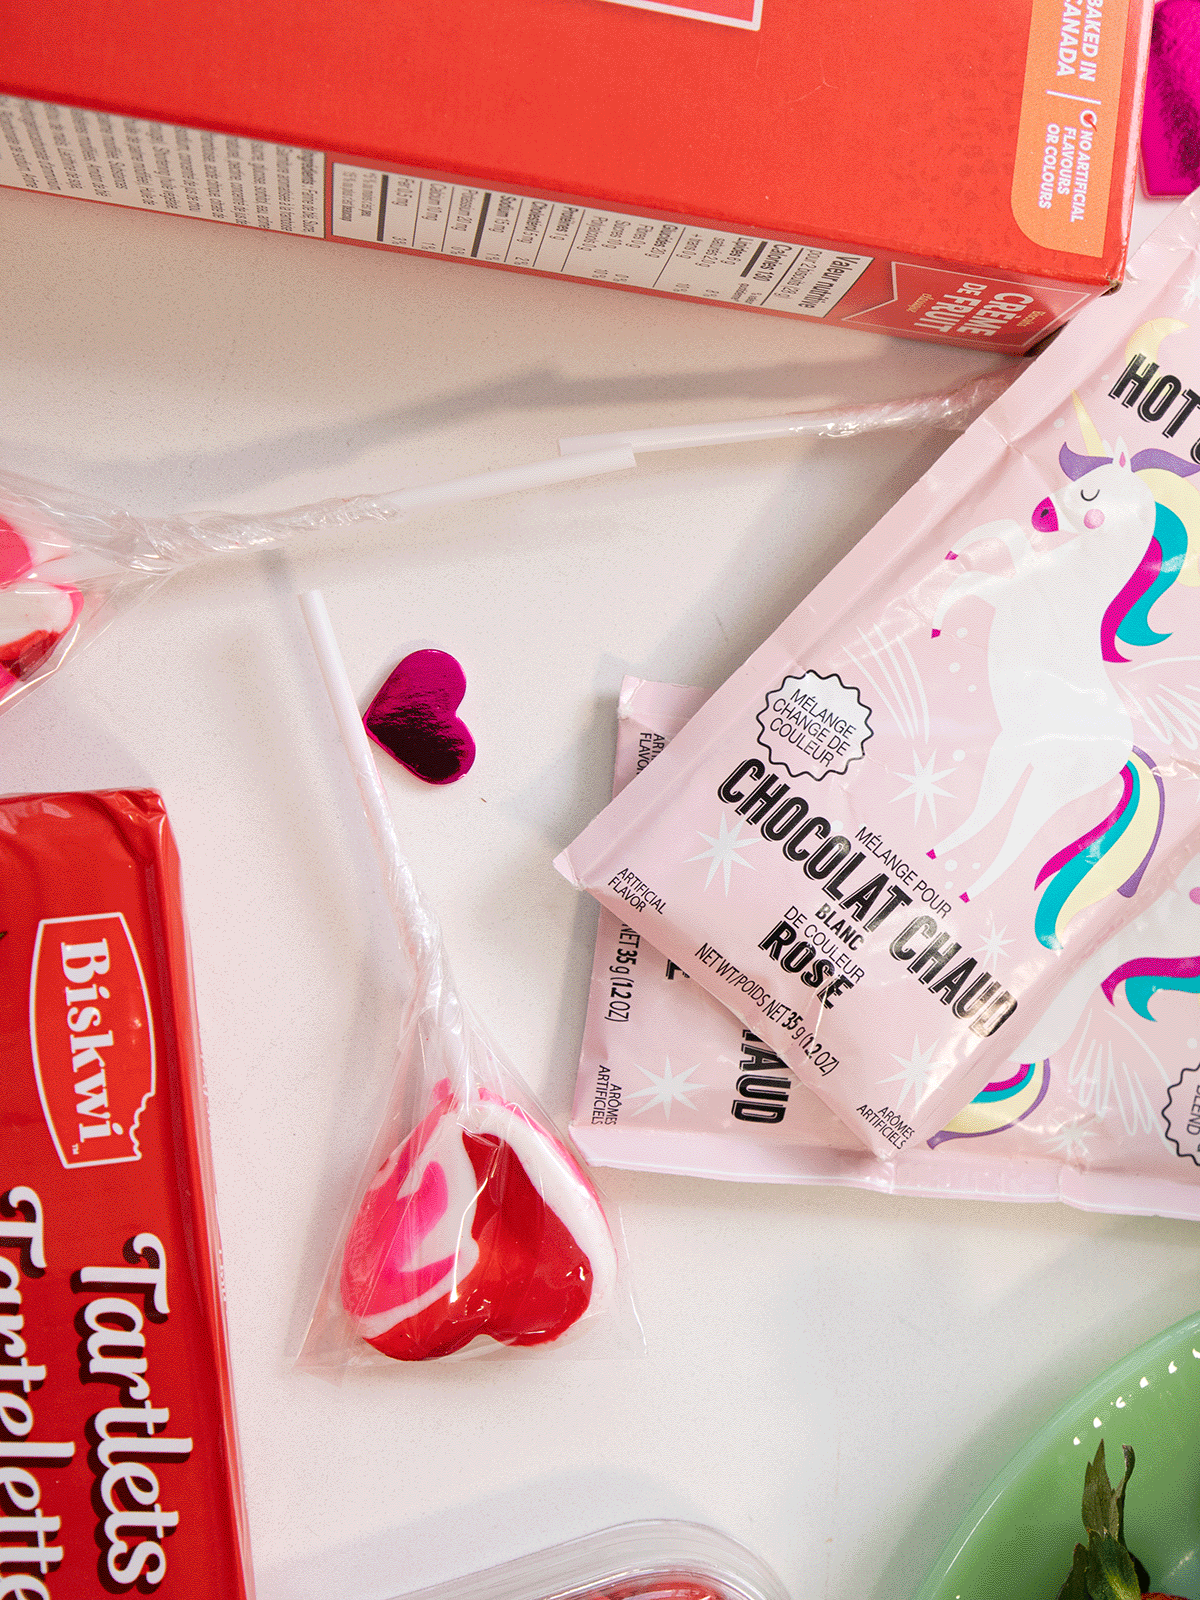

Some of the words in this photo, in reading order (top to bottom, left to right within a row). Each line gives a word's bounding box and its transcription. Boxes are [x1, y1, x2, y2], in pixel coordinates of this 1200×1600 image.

[1082, 0, 1103, 57] BAKED
[1079, 60, 1097, 82] IN
[1046, 123, 1060, 144] OR
[1079, 130, 1093, 151] NO
[1057, 126, 1077, 195] FLAVOURS
[1038, 145, 1058, 209] COLOURS
[1070, 151, 1091, 222] ARTIFICIAL
[497, 195, 517, 218] Sodium
[525, 201, 548, 232] Cholestérol
[556, 206, 579, 232] Protéines
[609, 220, 631, 238] Sucres
[654, 224, 678, 248] Glucides
[729, 237, 753, 257] Lipides
[760, 244, 793, 270] Calories
[804, 249, 823, 264] pour
[752, 271, 774, 282] 130
[821, 257, 861, 282] Valeur
[798, 281, 834, 308] nutritive
[957, 282, 987, 296] DE
[914, 294, 982, 332] FRUIT
[956, 292, 1034, 336] CRÈME
[772, 698, 830, 743] CHANGE
[827, 735, 851, 756] DE
[790, 688, 856, 739] MÉLANGE
[769, 717, 834, 767] COULEUR
[855, 826, 918, 886] MÉLANGE
[912, 879, 952, 919] POUR
[608, 876, 646, 913] FLAVOR
[615, 868, 666, 915] ARTIFICIAL
[717, 758, 913, 932] CHOCOLAT
[889, 916, 1018, 1037] CHAUD
[619, 923, 639, 948] NET
[815, 903, 863, 951] BLANC
[616, 948, 638, 965] 35
[694, 942, 722, 968] NET
[783, 905, 808, 929] DE
[804, 924, 865, 984] COULEUR
[609, 965, 630, 974] g
[757, 920, 853, 1009] ROSE
[610, 977, 634, 999] (1.2
[715, 956, 771, 1007] WT/POIDS
[604, 1001, 630, 1022] OZ)
[762, 999, 791, 1023] NET
[781, 1011, 803, 1030] 35
[60, 940, 124, 1140] Biskwi
[791, 1026, 806, 1040] g
[798, 1033, 822, 1059] (1.2
[814, 1051, 839, 1077] OZ)
[591, 1064, 611, 1125] ARTIFICIELS
[603, 1082, 622, 1125] ARÔMES
[856, 1104, 906, 1150] ARTIFICIELS
[877, 1106, 915, 1140] ARÔMES
[80, 1233, 193, 1584] Tartlets
